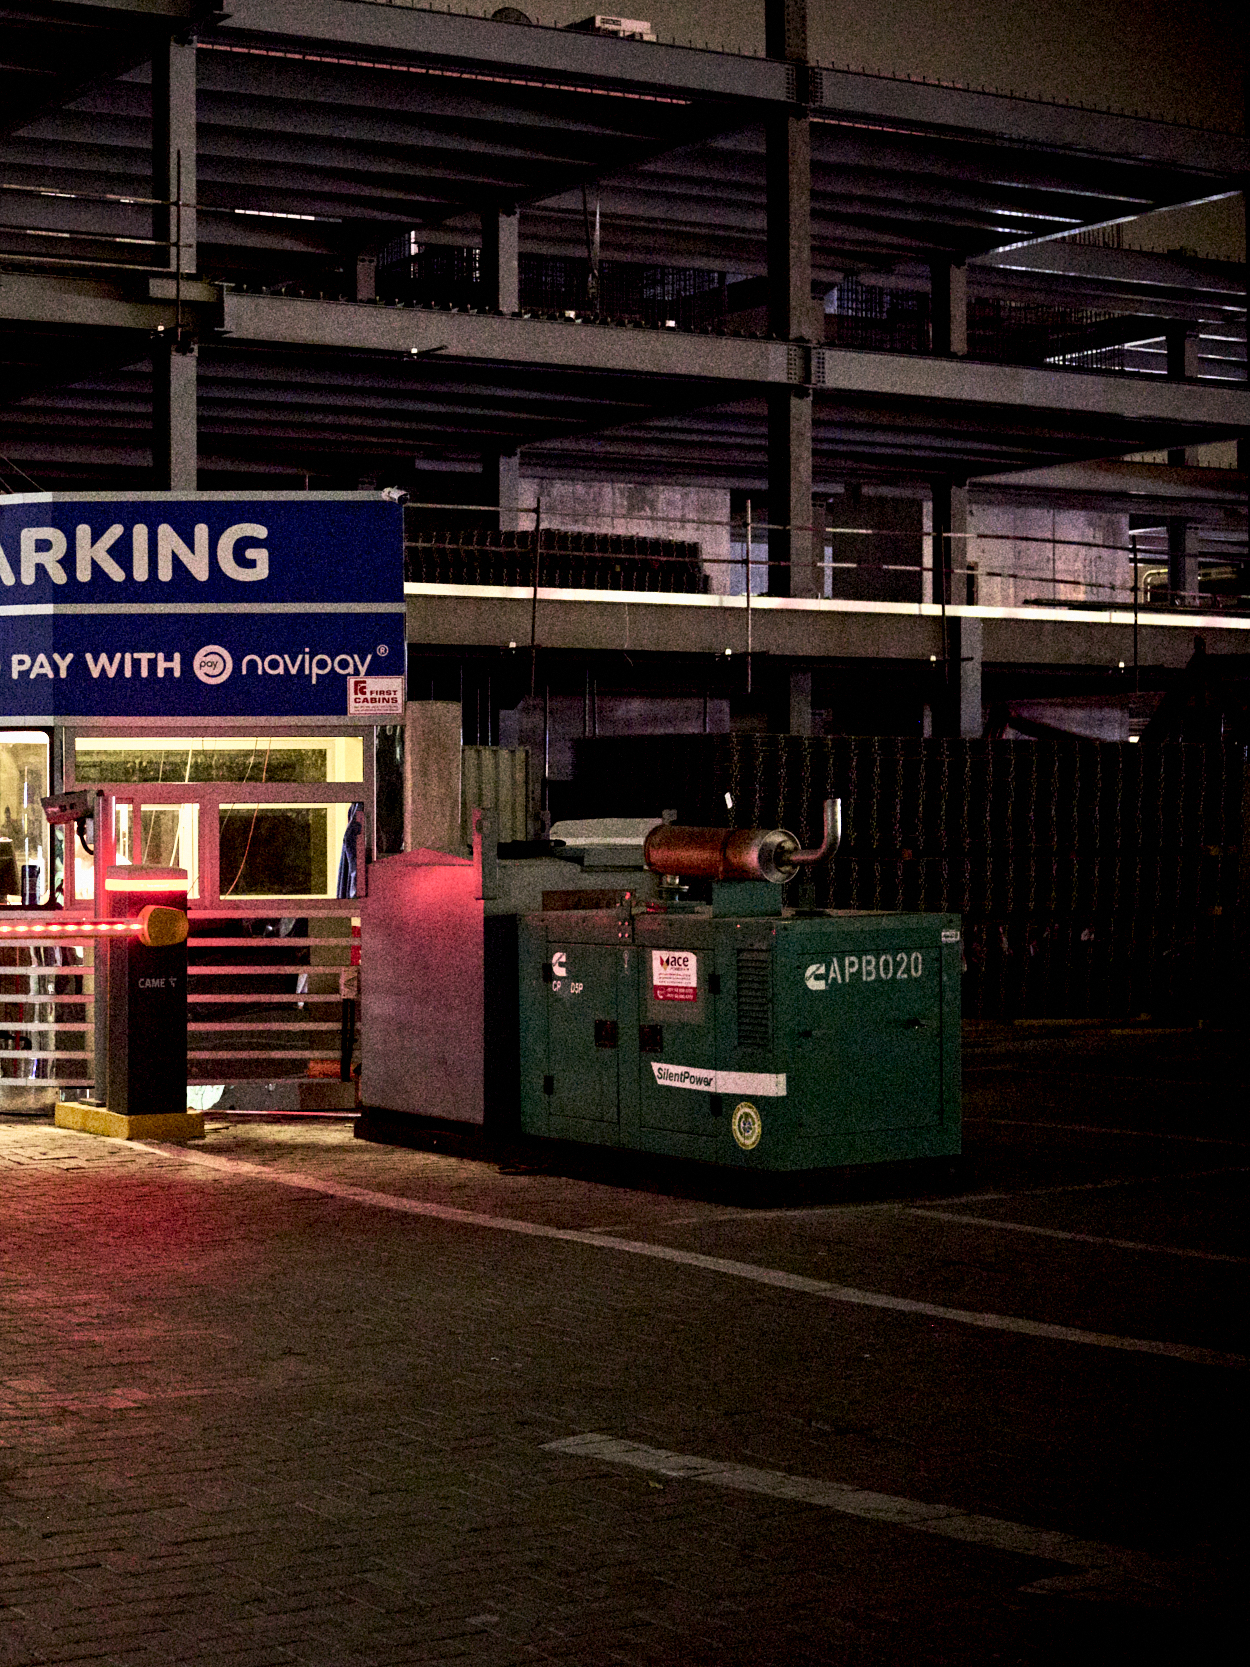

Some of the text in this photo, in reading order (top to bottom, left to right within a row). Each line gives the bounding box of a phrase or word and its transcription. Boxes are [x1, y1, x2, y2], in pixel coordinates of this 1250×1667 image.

[11, 653, 74, 680] PAY
[85, 652, 181, 679] WITH
[199, 660, 218, 671] pay
[138, 977, 166, 988] CAME
[656, 1067, 713, 1087] SilentPower
